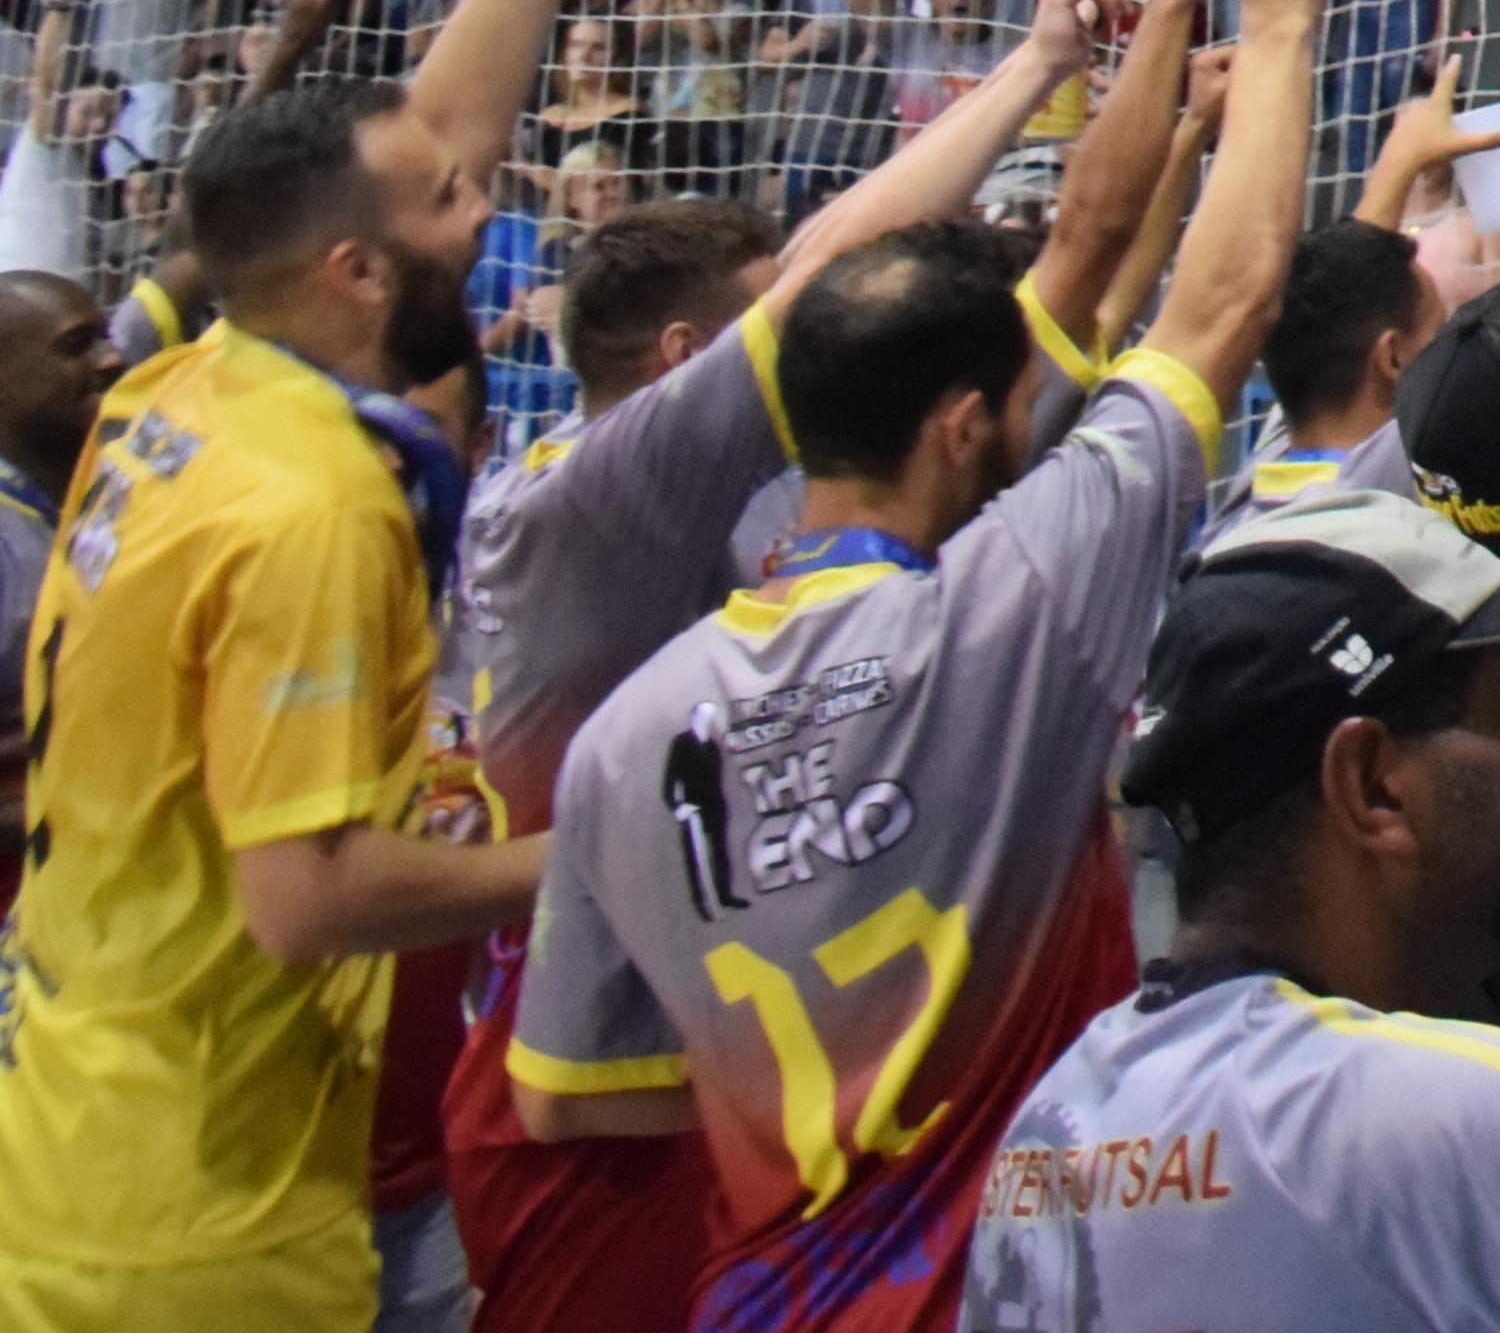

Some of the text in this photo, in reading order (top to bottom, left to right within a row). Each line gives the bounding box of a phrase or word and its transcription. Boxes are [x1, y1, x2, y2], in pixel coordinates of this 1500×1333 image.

[743, 737, 839, 817] THE
[748, 777, 914, 895] END
[703, 887, 973, 1221] 17
[1061, 1128, 1233, 1215] FUTSAL
